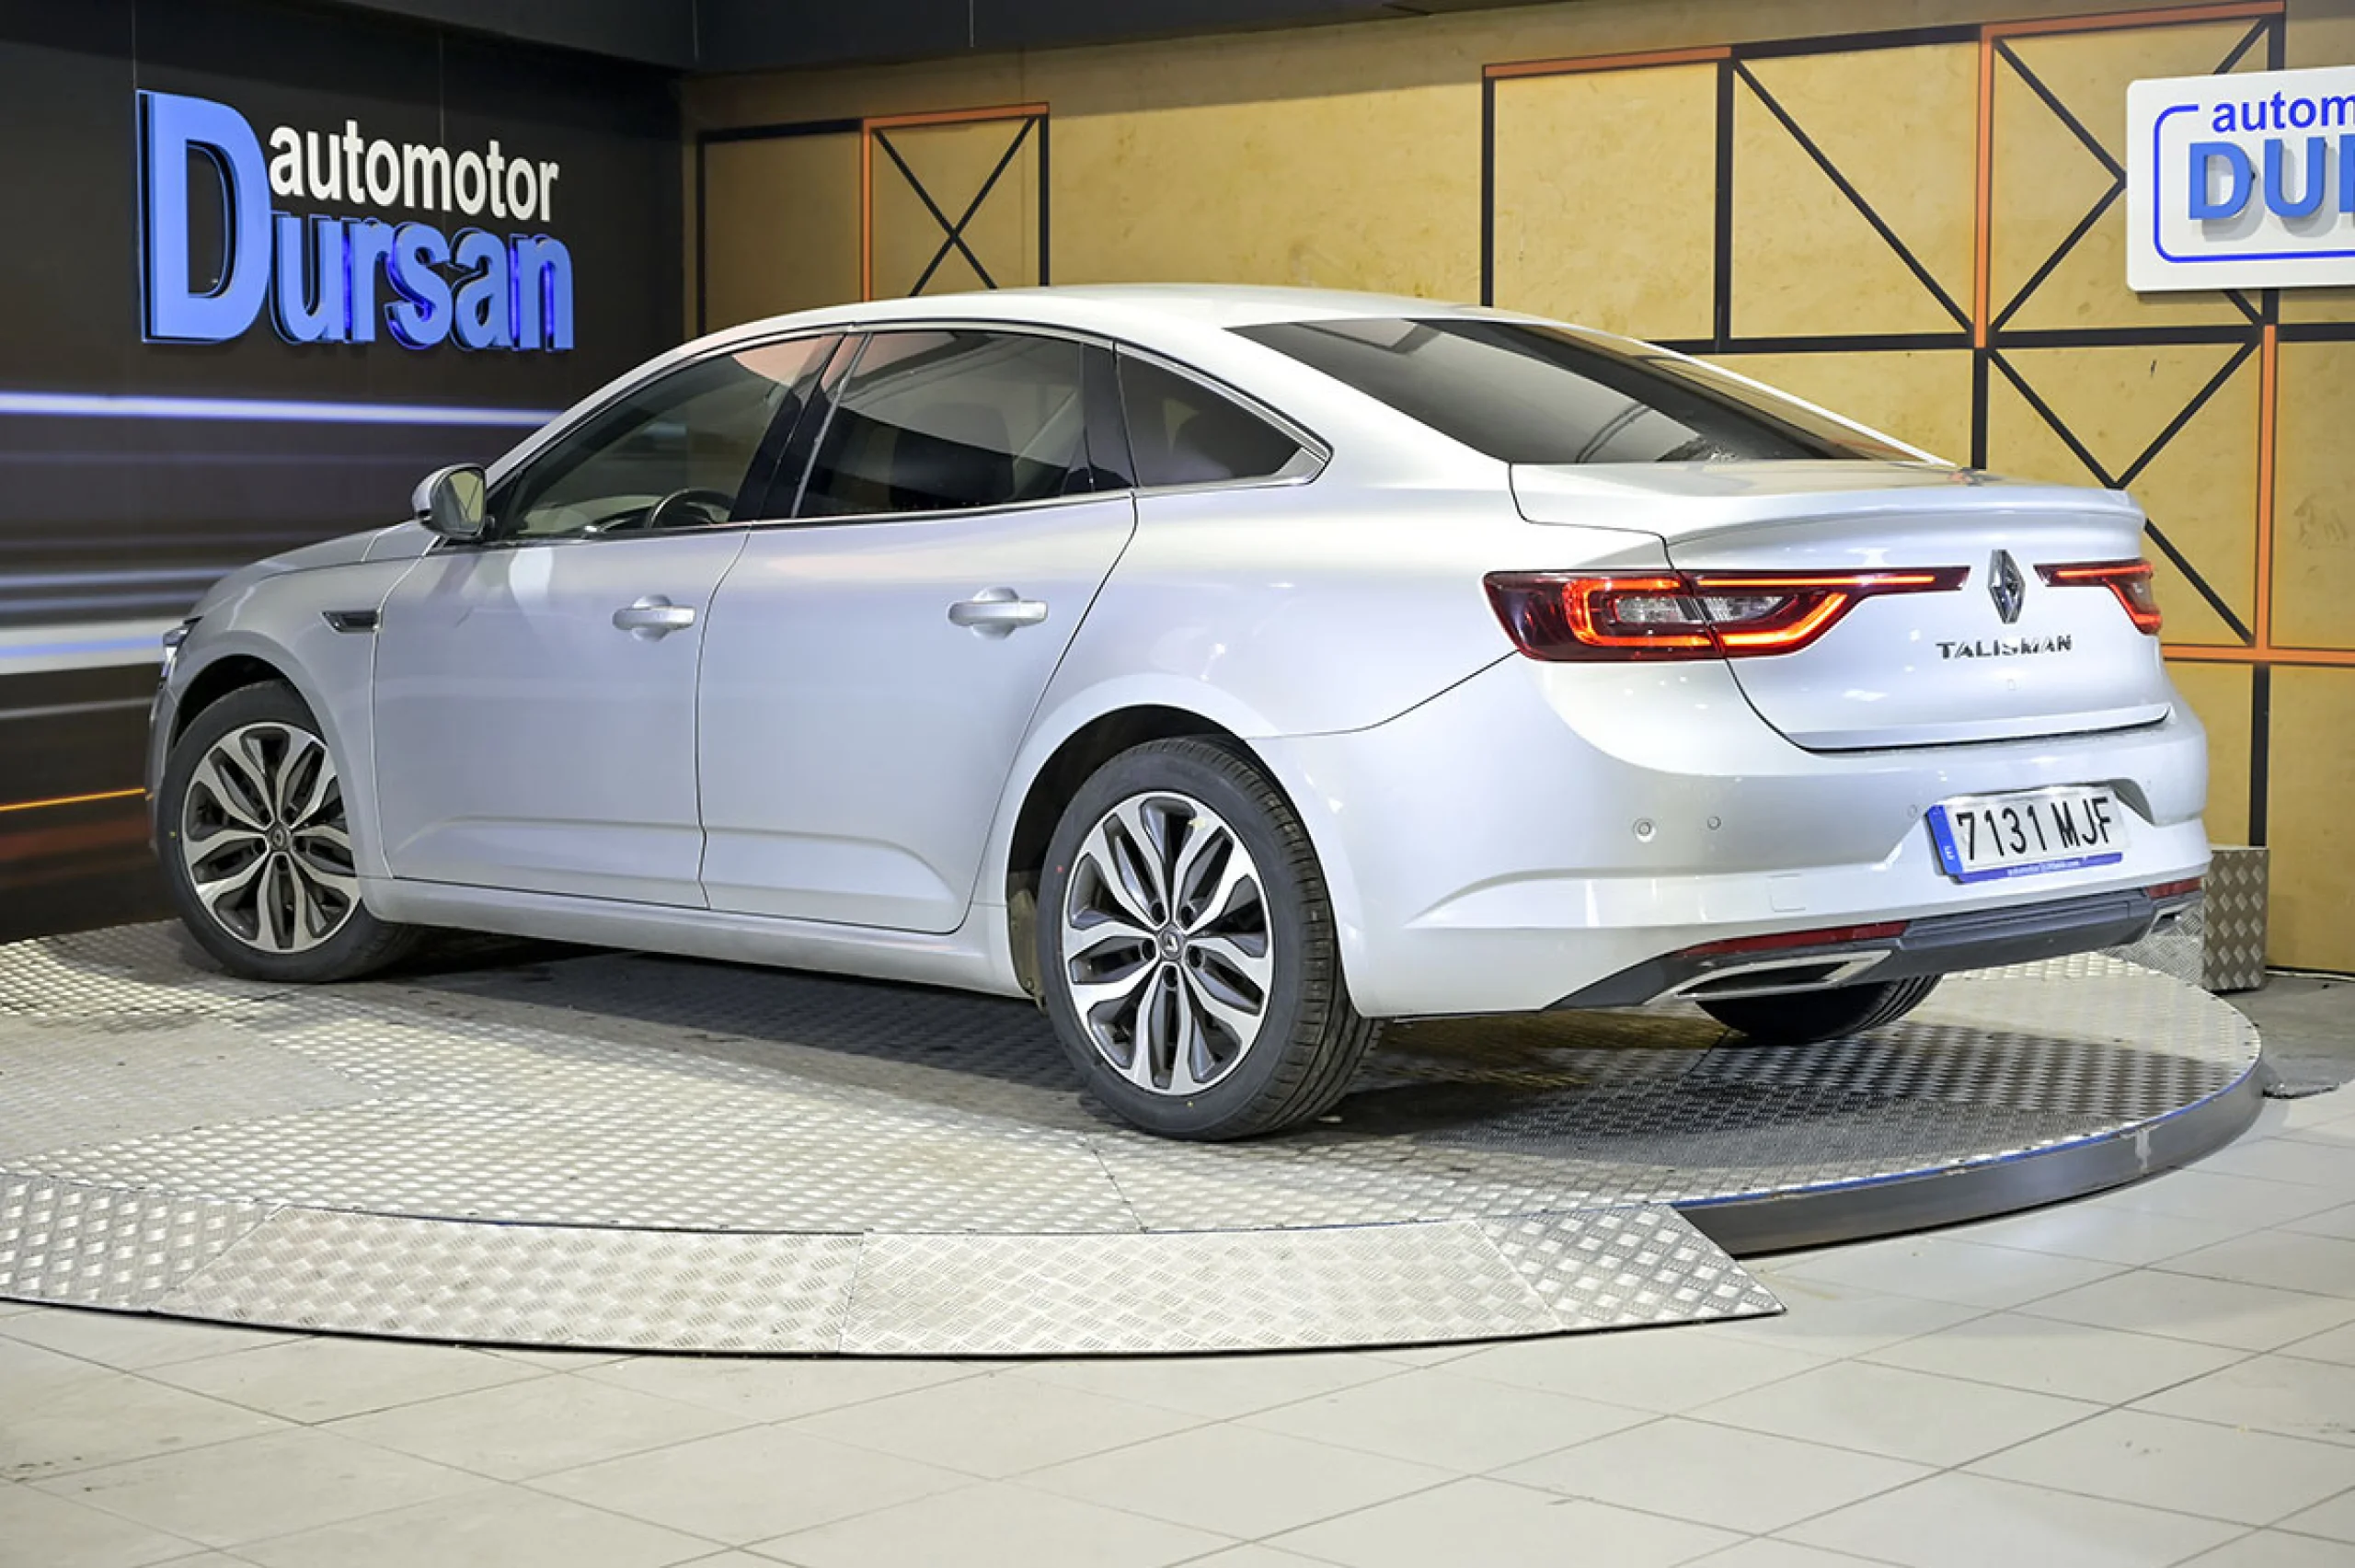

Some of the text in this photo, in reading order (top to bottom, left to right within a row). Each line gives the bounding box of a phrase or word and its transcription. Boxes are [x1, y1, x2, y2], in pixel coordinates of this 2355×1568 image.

[269, 119, 560, 223] automotor
[2187, 133, 2355, 221] DU
[136, 88, 574, 351] Dursan
[1935, 634, 2073, 659] TALISMAN
[1955, 795, 2112, 861] 7131 MJF
